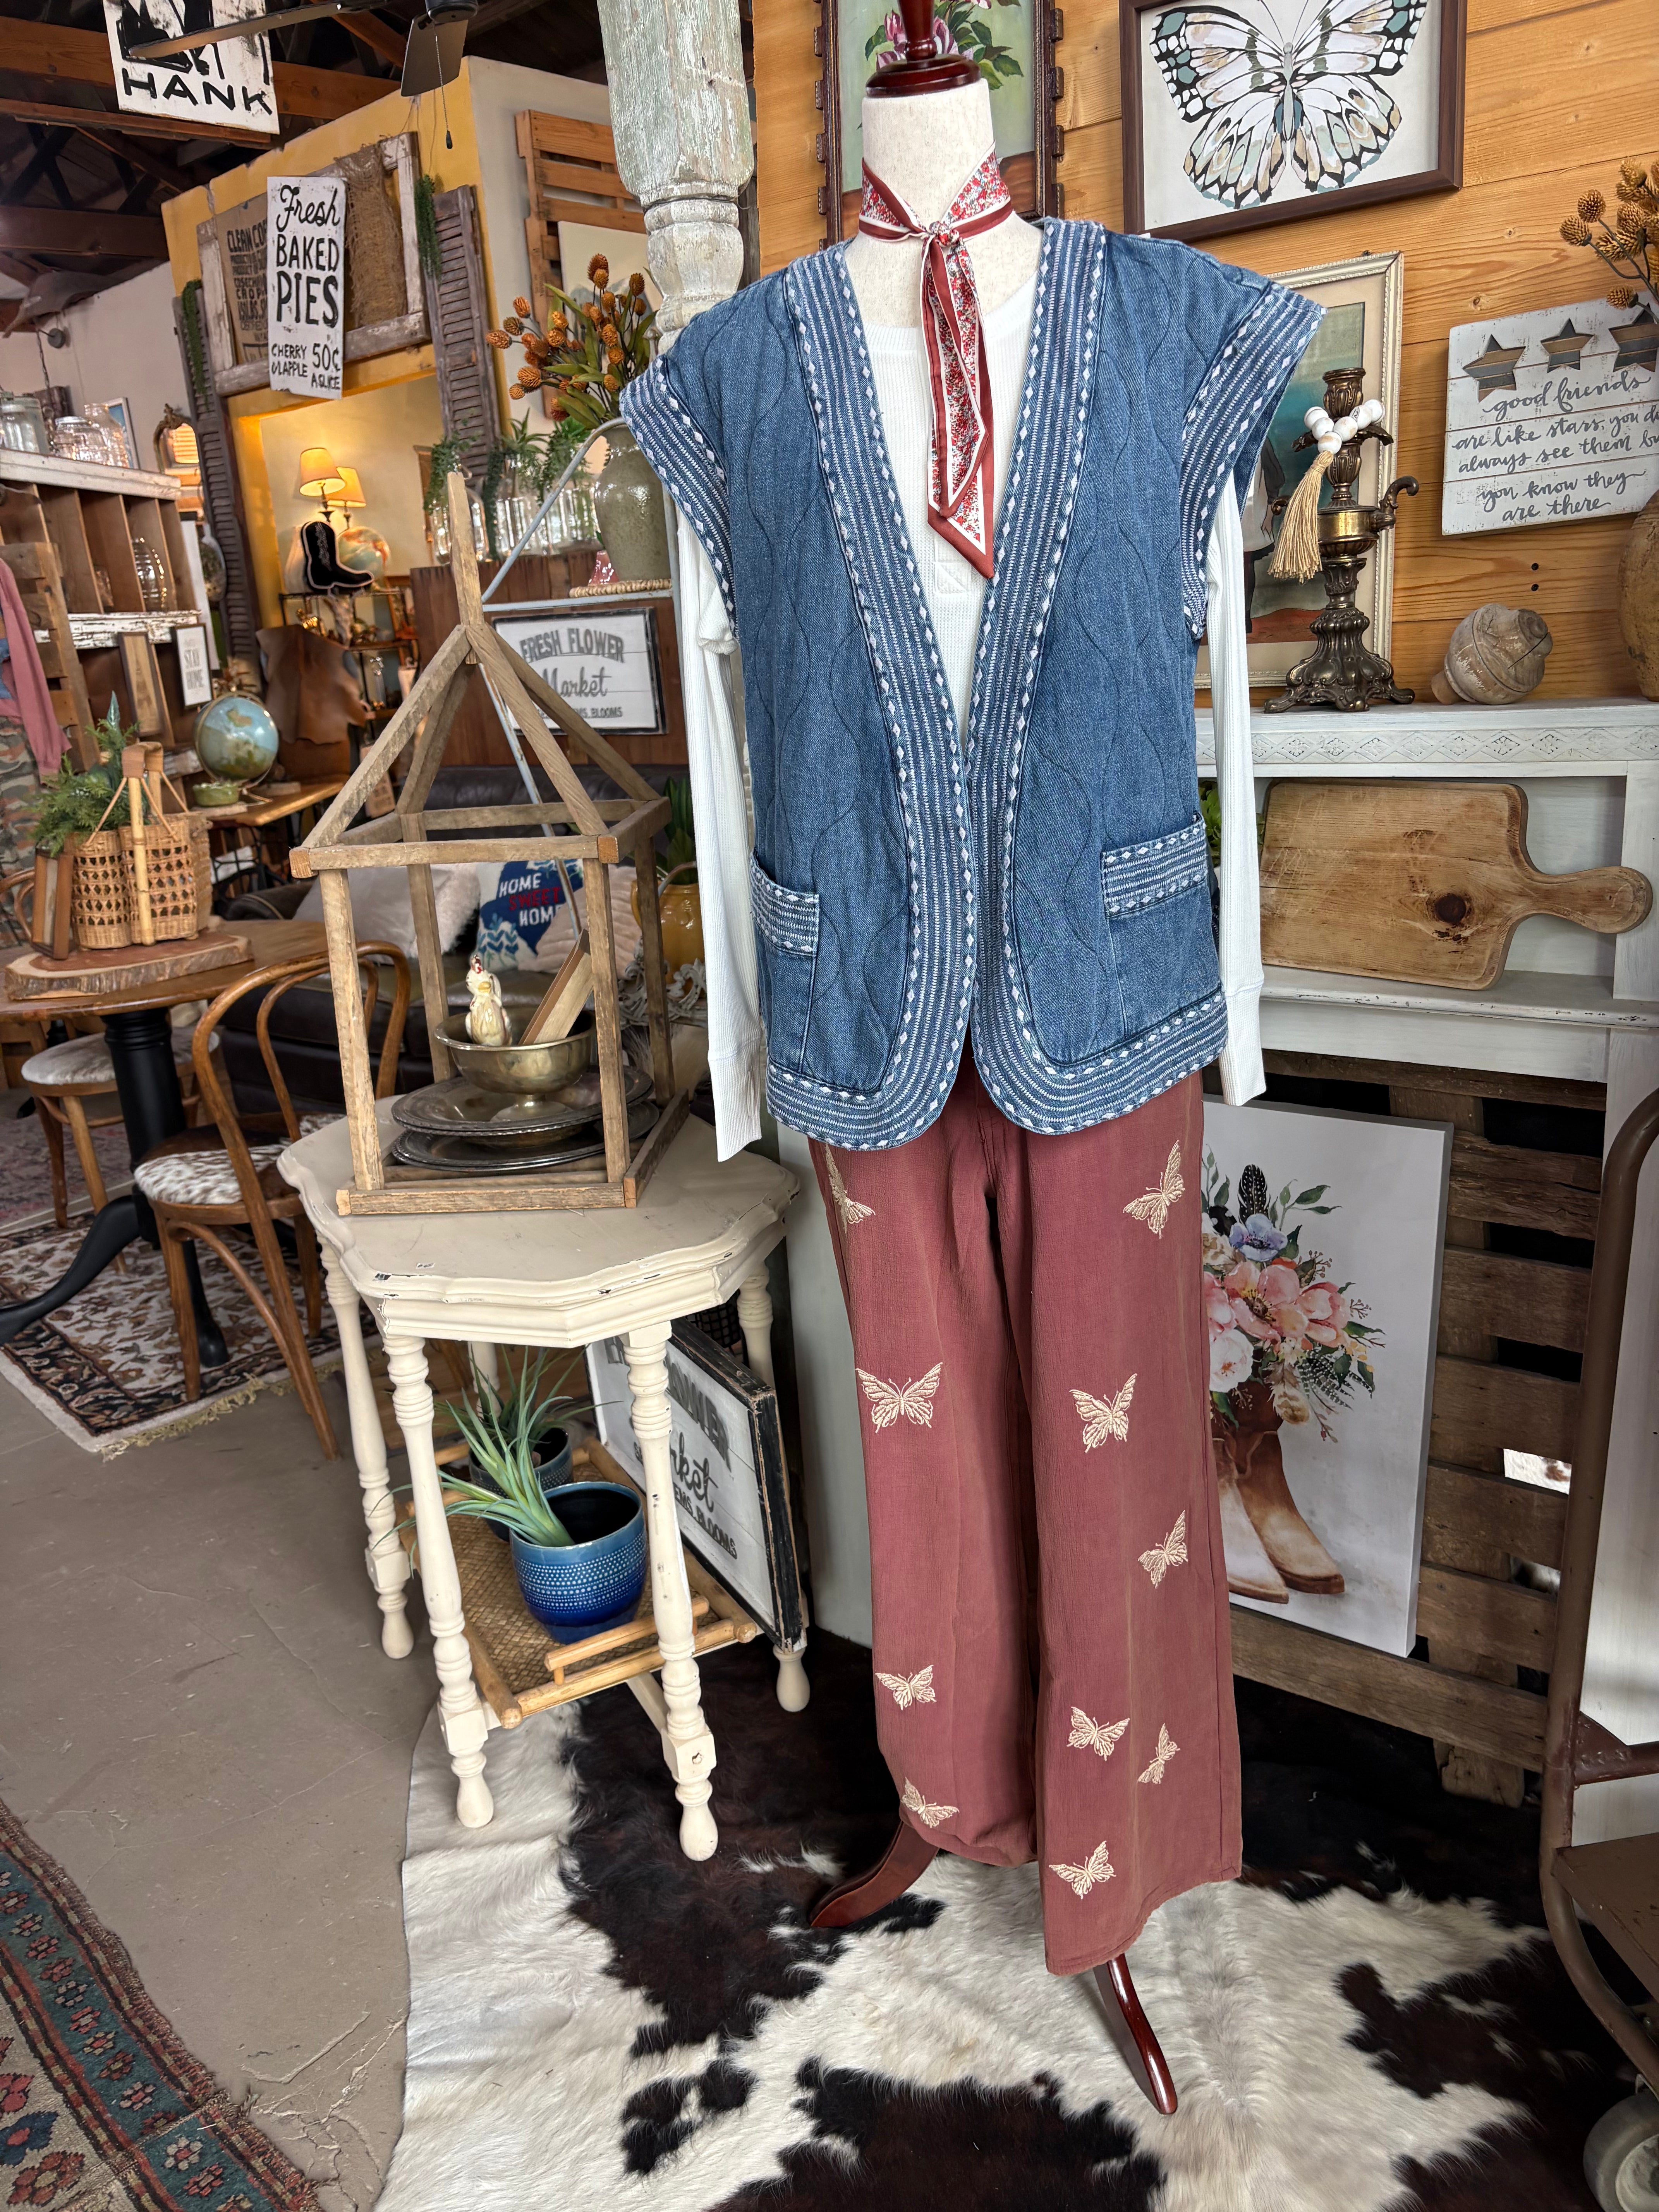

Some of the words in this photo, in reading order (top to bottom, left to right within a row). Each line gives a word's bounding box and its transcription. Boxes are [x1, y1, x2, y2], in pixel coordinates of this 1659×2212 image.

[122, 68, 272, 115] HANK
[276, 185, 340, 232] Fresh
[276, 234, 339, 272] BAKED
[276, 271, 338, 328] PIES
[271, 343, 307, 359] CHERRY
[283, 361, 308, 378] APPLE
[1482, 381, 1553, 422] good
[1553, 370, 1651, 412] friends
[1452, 435, 1488, 450] are
[1491, 424, 1541, 447] like
[1546, 417, 1605, 438] stars,
[1609, 413, 1639, 438] you
[1458, 452, 1532, 473] always
[1535, 447, 1574, 463] see
[1578, 435, 1632, 455] them
[1476, 486, 1518, 513] you
[1522, 481, 1578, 498] know
[1583, 471, 1646, 495] they
[1503, 505, 1540, 521] are
[1546, 494, 1611, 515] there
[519, 630, 562, 661] FRESH
[567, 628, 624, 663] FLOWER
[499, 872, 542, 898] HOME
[508, 887, 561, 911] SWEET
